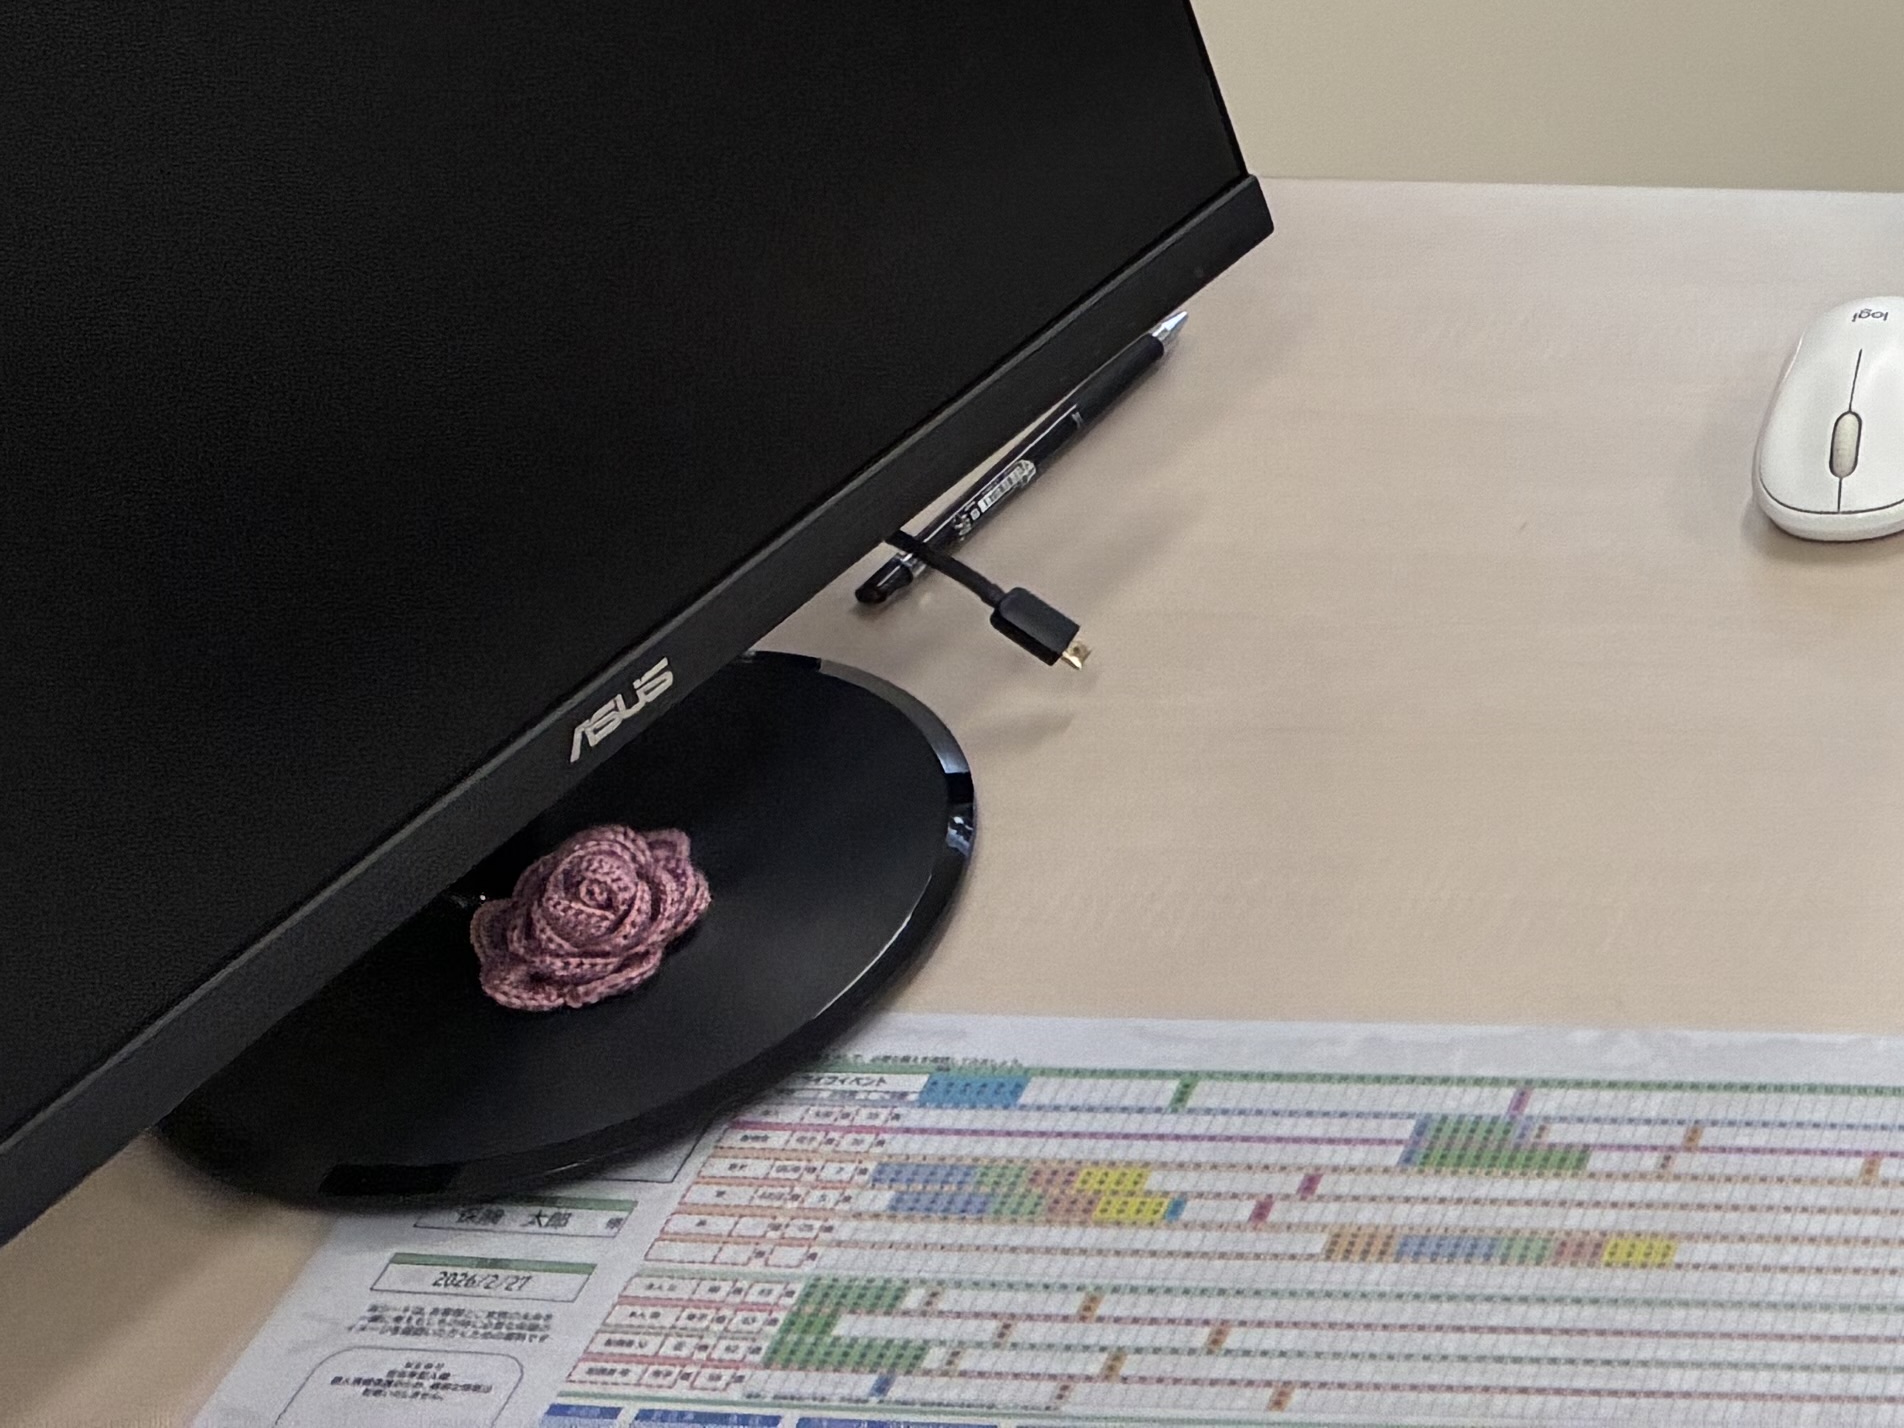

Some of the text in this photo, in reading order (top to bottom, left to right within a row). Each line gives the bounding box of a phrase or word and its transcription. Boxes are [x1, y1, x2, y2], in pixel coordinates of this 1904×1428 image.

[1851, 308, 1889, 323] logi
[570, 657, 674, 763] ASUS
[431, 1270, 534, 1293] 2026/2/27
